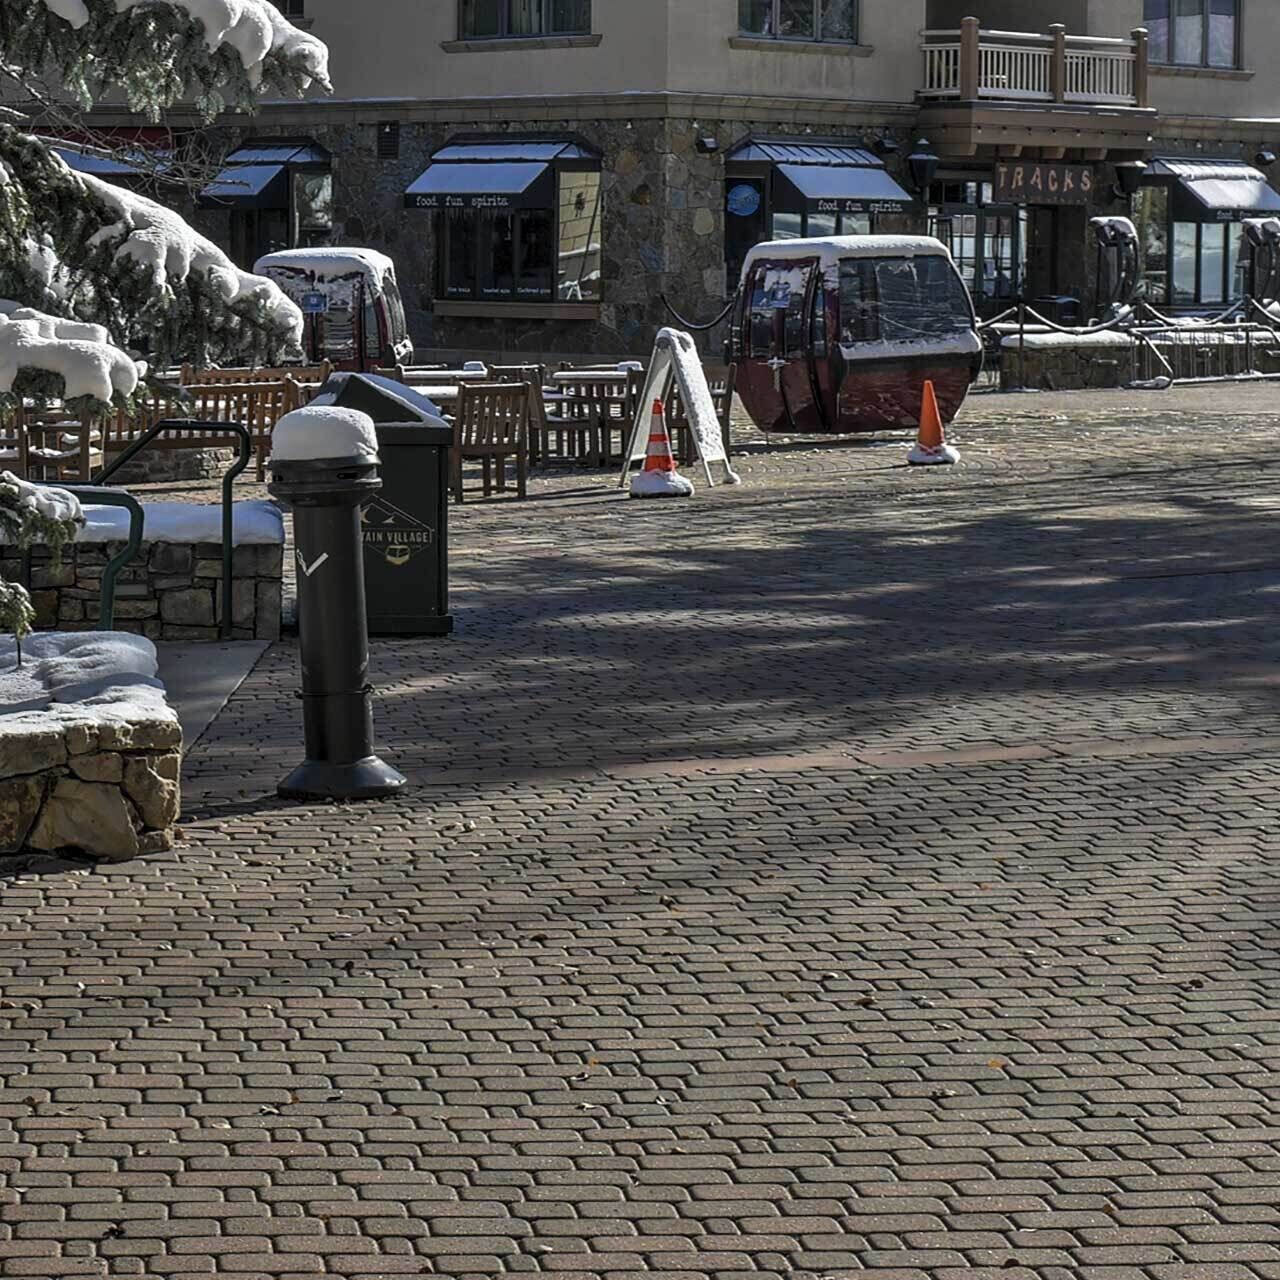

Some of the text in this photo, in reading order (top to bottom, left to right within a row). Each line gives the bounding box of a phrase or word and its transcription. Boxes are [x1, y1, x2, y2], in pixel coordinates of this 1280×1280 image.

[999, 166, 1091, 192] TRACKS
[416, 195, 509, 208] food fun spirits
[818, 199, 903, 214] food fun spirits
[386, 531, 429, 544] VILLAGE
